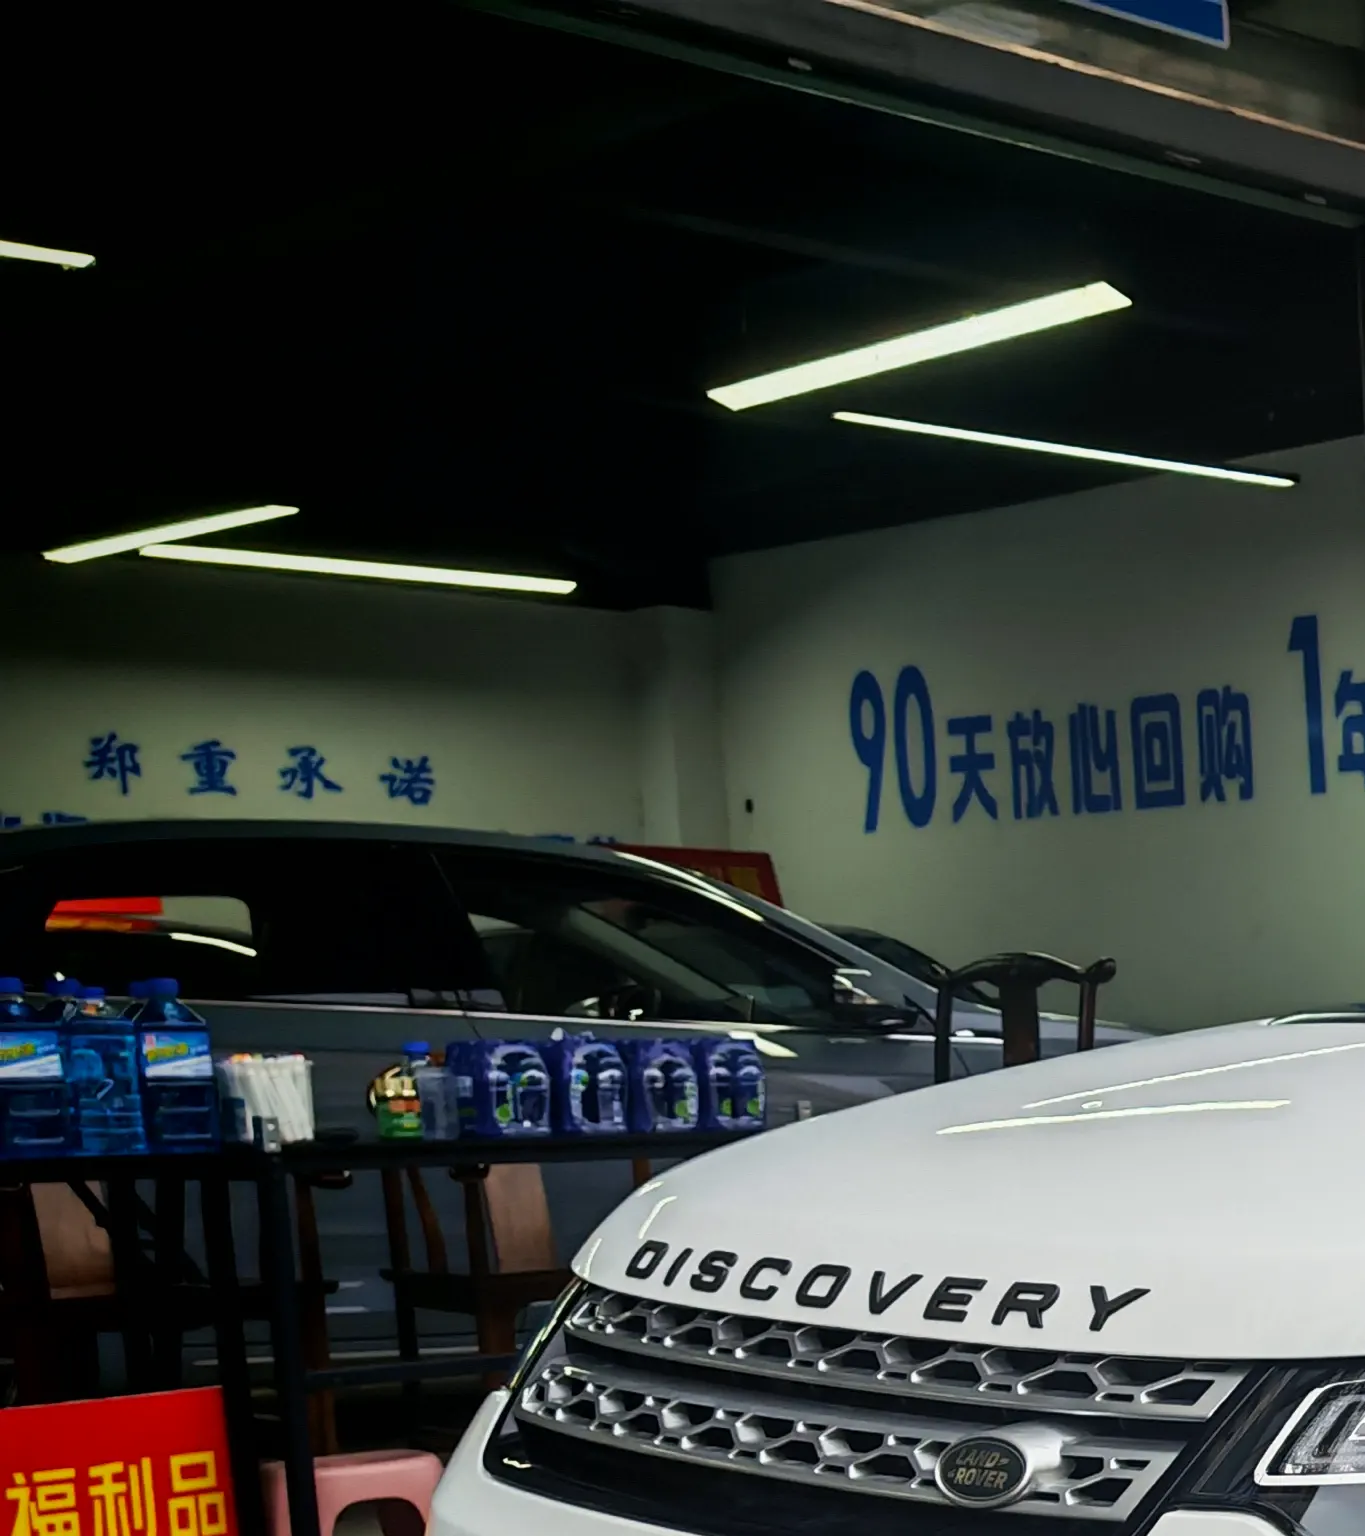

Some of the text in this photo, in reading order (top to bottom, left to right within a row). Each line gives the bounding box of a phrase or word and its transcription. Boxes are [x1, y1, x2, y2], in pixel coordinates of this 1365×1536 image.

[83, 732, 436, 806] 郑重承诺
[849, 665, 1254, 834] 90天放心回购
[625, 1240, 1151, 1331] DISCOVERY
[953, 1467, 1009, 1489] ROVER
[956, 1449, 1001, 1468] LAND
